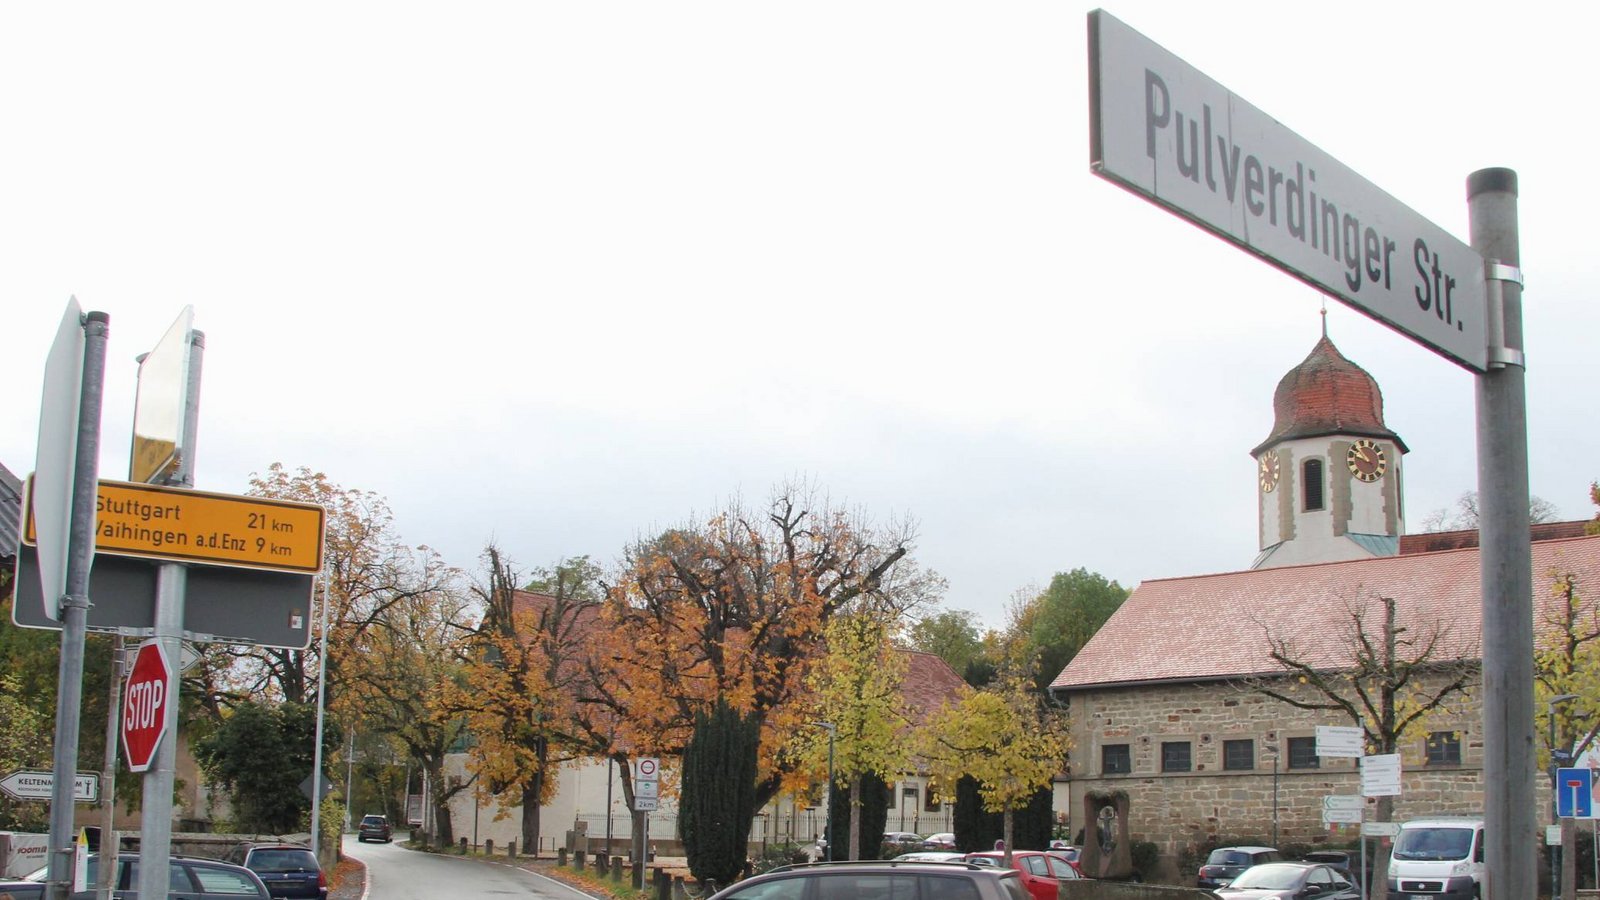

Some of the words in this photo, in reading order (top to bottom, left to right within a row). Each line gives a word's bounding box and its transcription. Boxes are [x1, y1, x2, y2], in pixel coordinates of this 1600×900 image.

[1144, 68, 1396, 292] Pulverdinger
[1414, 238, 1463, 332] Str.
[97, 495, 180, 522] Stuttgart
[248, 513, 266, 529] 21
[271, 520, 294, 533] km
[196, 533, 246, 552] a.d.Enz
[256, 537, 266, 553] 9
[271, 543, 292, 557] km
[127, 679, 163, 731] STOP
